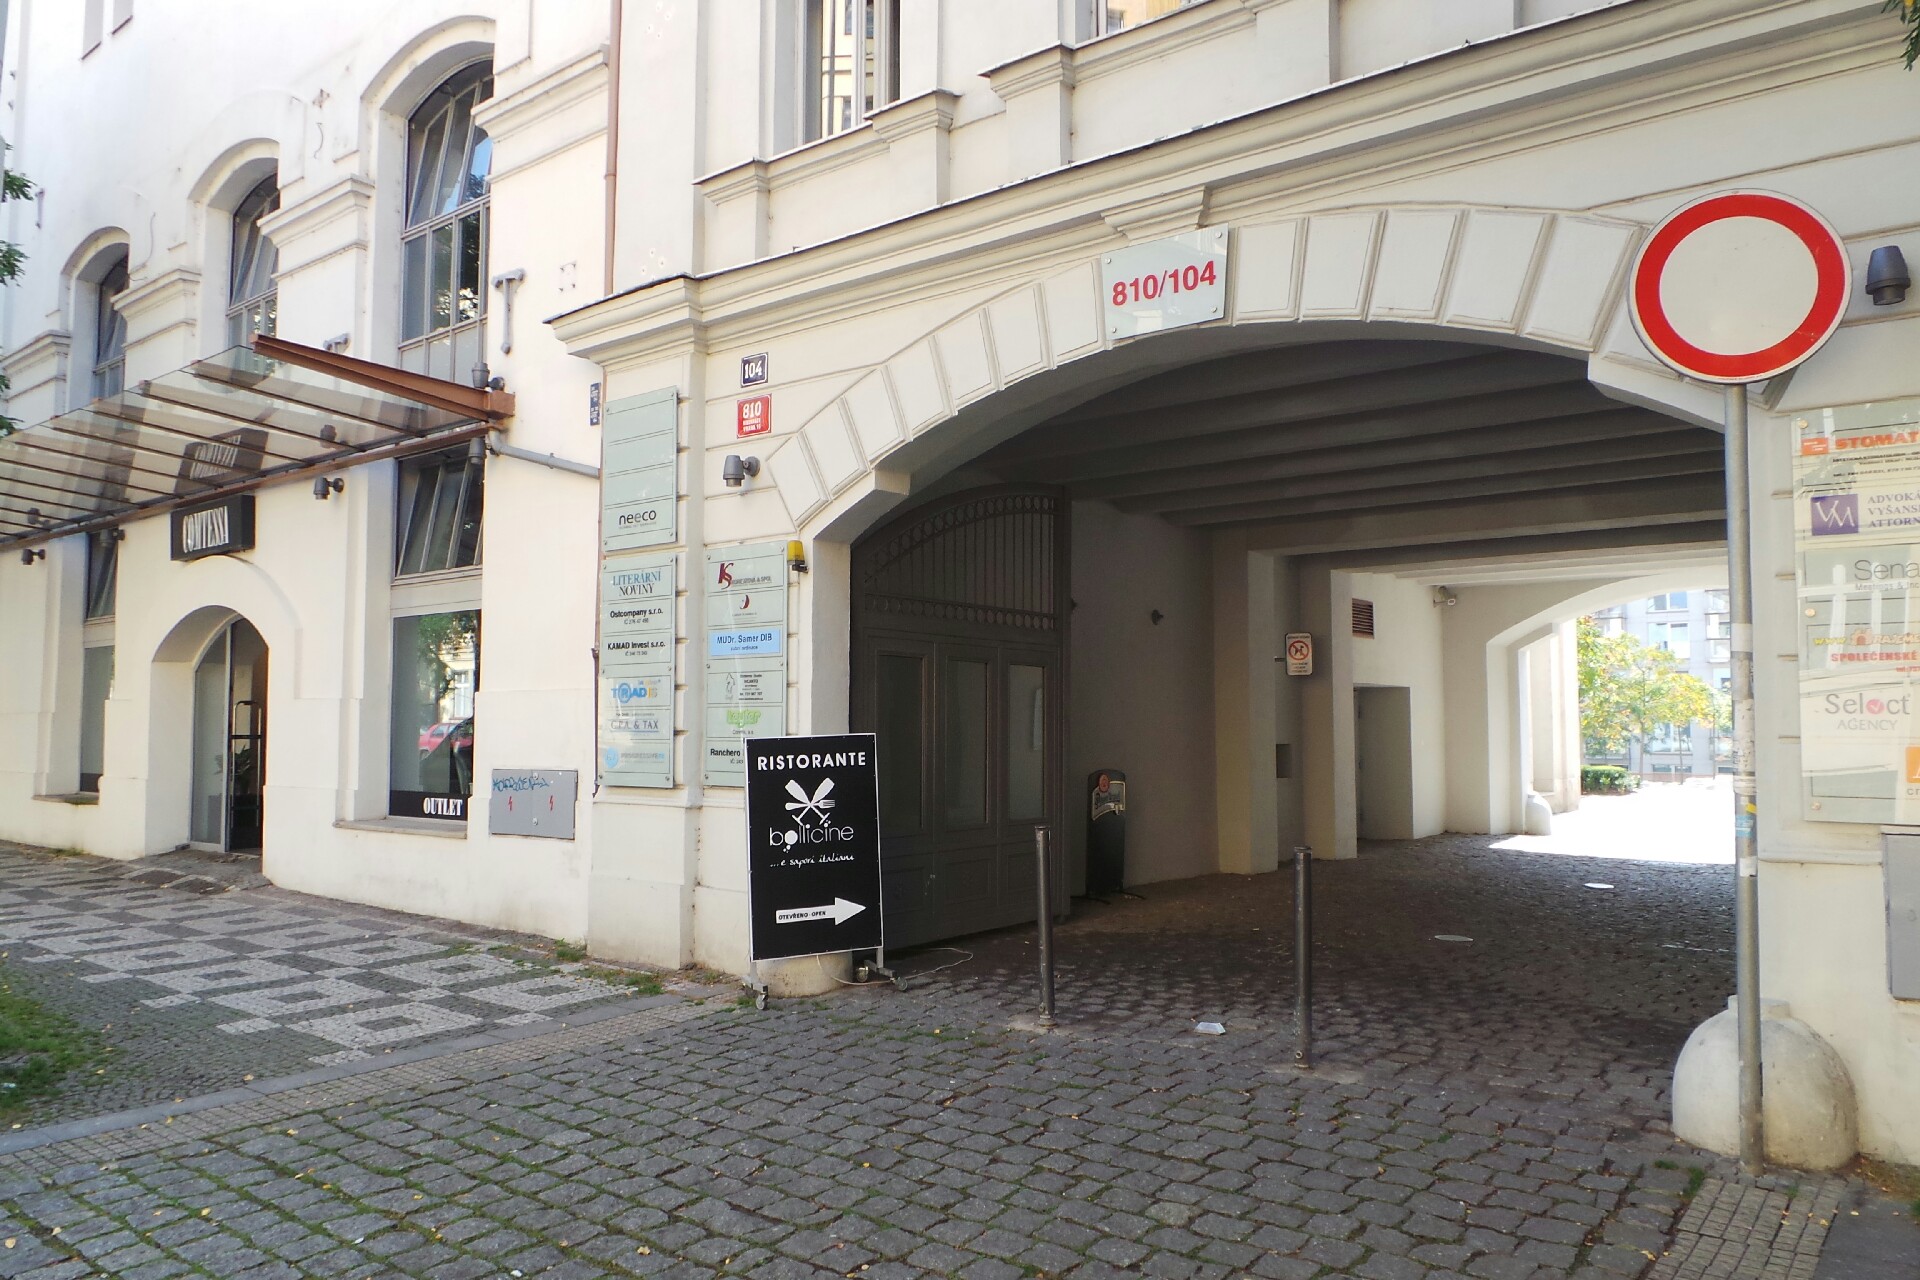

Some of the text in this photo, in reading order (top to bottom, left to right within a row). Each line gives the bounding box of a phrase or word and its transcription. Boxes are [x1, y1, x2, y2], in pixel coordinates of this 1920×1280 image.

[1112, 260, 1216, 306] 810/104
[744, 360, 763, 379] 104
[743, 400, 762, 419] 810
[619, 510, 657, 526] neeco
[619, 583, 655, 597] NOVINY
[648, 607, 664, 615] s.r.o.
[717, 632, 773, 645] MUDr. Samer DIB
[608, 641, 630, 651] KAMAD
[1831, 649, 1918, 662] SPOLEČENSKÉ
[643, 719, 659, 730] TAX
[1837, 718, 1898, 731] AGENCY
[710, 748, 741, 757] Ranchero
[757, 751, 867, 771] RISTORANTE
[423, 797, 463, 816] OUTLET
[769, 823, 854, 848] bollicine
[789, 855, 816, 869] sapori
[778, 912, 809, 921] OTEVŘENO
